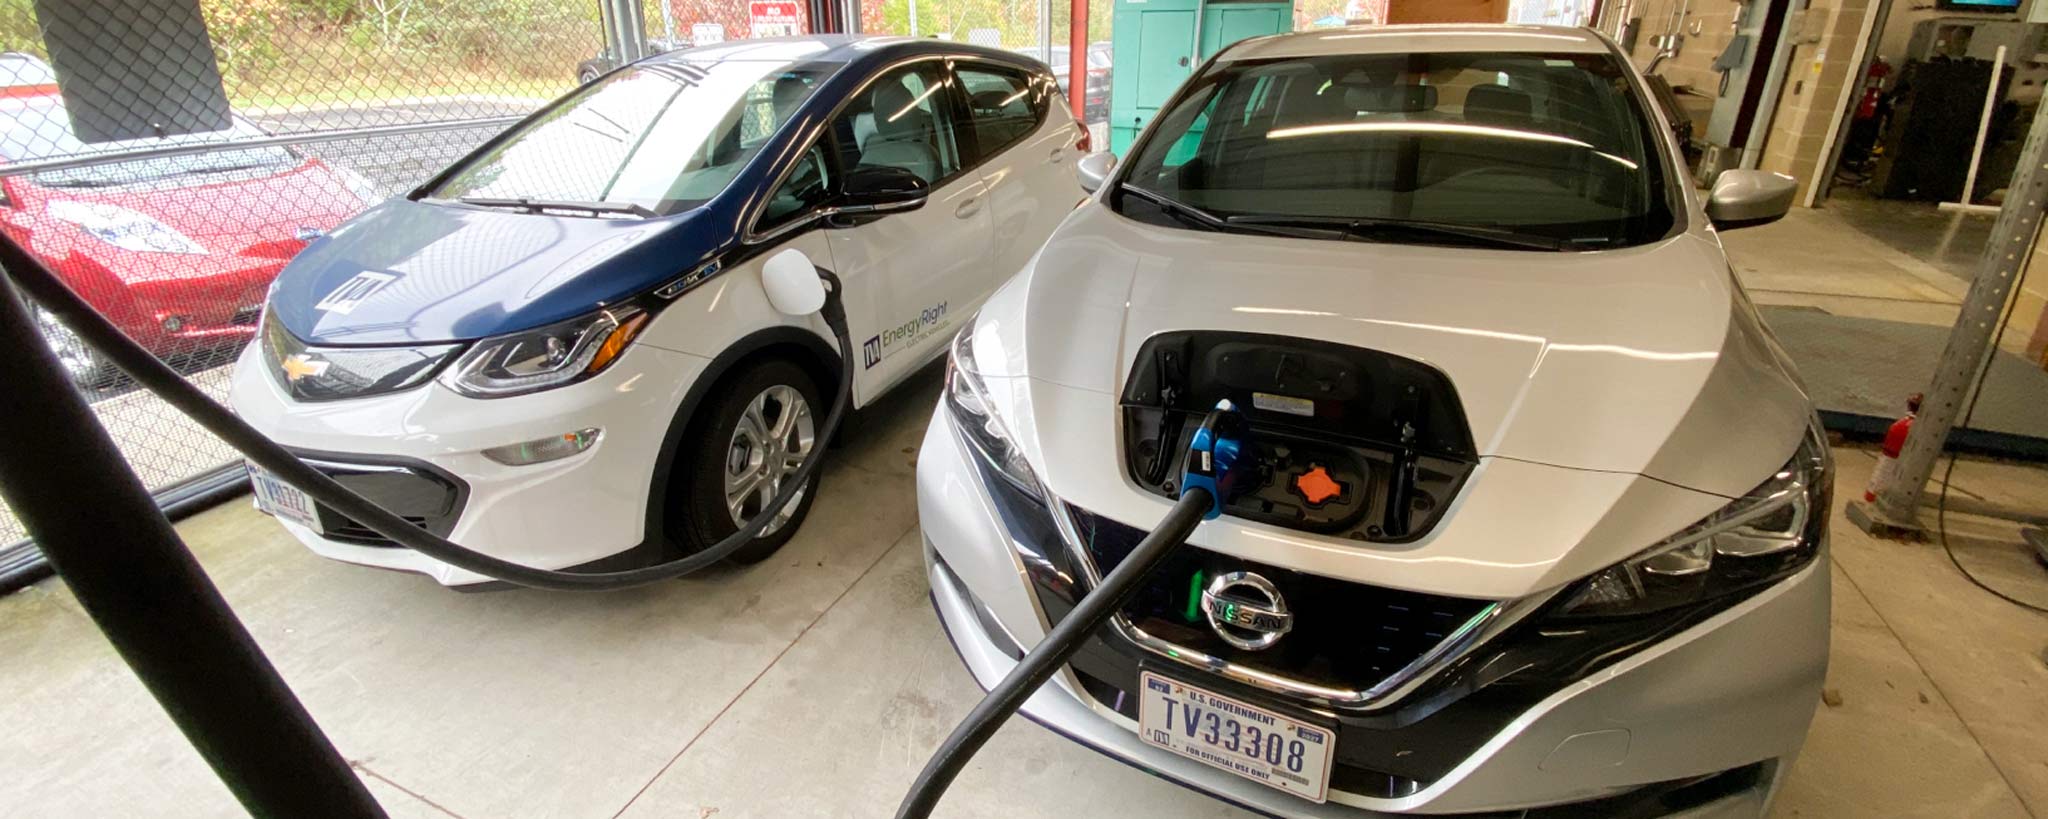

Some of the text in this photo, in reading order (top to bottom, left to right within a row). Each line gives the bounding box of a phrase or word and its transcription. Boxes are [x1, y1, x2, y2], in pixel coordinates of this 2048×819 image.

[882, 301, 947, 347] EnergyRight
[864, 334, 881, 370] TVA
[1208, 600, 1280, 630] NISSAN
[1189, 691, 1276, 726] U.S. GOVERNMENT
[1162, 696, 1306, 773] TV33308
[1186, 746, 1271, 781] FOR OFFICIAL USE ONLY
